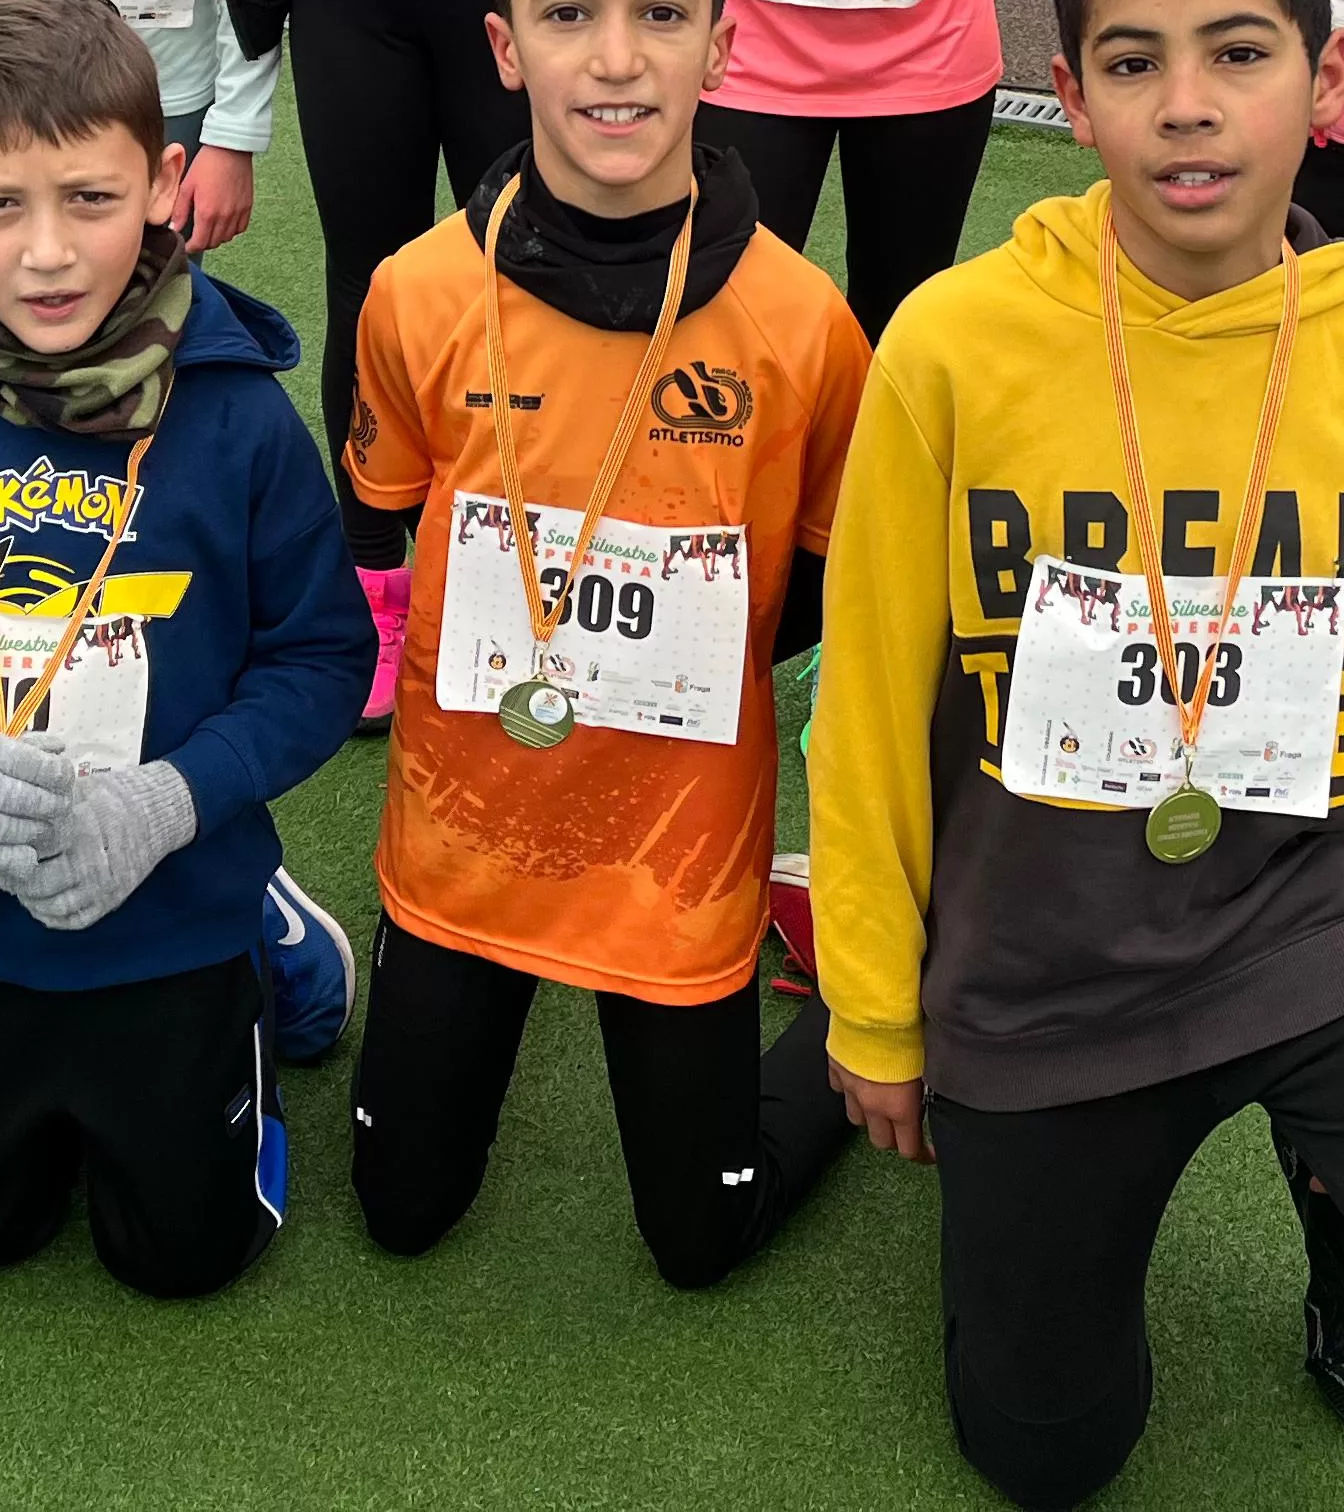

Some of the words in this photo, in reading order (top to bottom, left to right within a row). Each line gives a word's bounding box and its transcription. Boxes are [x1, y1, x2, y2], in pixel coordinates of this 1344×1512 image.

[648, 427, 745, 448] ATLETISMO
[543, 528, 575, 548] San
[539, 567, 656, 641] 309
[1116, 641, 1244, 708] 303
[1279, 749, 1303, 761] Fraga
